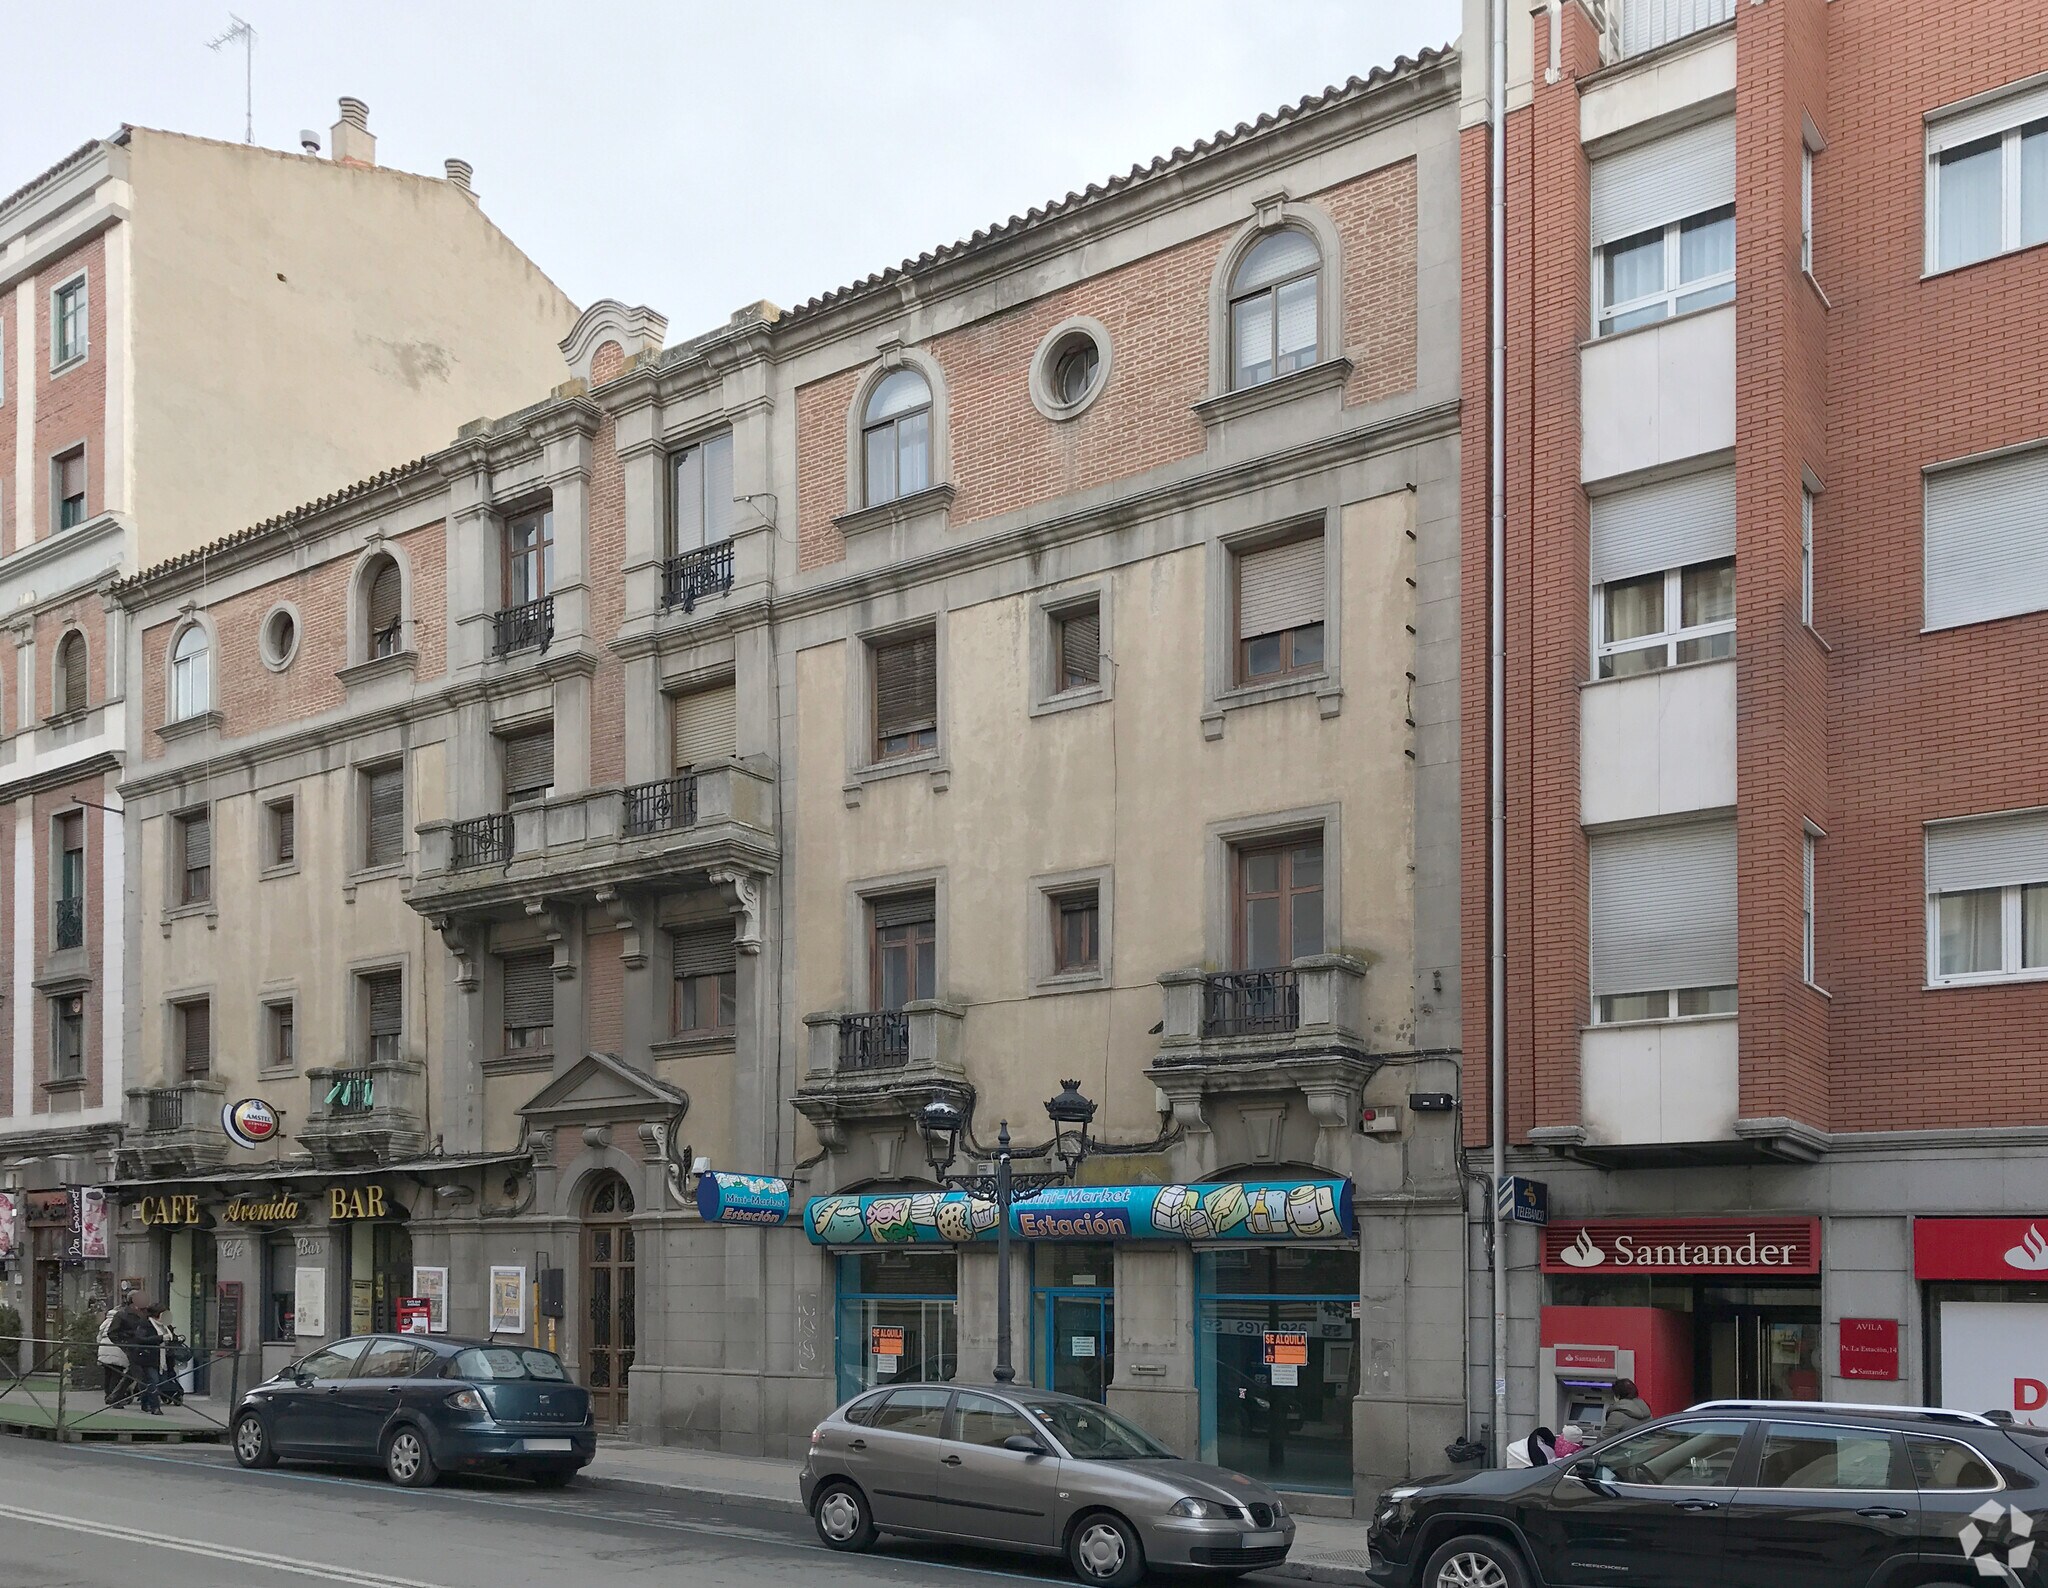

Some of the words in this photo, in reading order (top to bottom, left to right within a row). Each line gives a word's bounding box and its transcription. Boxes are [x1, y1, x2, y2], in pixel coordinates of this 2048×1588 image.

[246, 1113, 272, 1122] AMSTEL
[68, 1189, 81, 1233] Gourmet
[221, 1192, 299, 1223] Avenida
[329, 1185, 386, 1219] BAR
[721, 1207, 780, 1223] Estación
[1516, 1205, 1545, 1221] TELEBANCO
[1019, 1210, 1127, 1236] Estación
[68, 1238, 81, 1256] Don
[297, 1238, 322, 1256] Bar
[1614, 1232, 1797, 1266] Santander
[872, 1328, 880, 1338] SE
[880, 1328, 902, 1338] ALQUILA
[1856, 1323, 1883, 1331] AVILA
[1265, 1333, 1275, 1345] SE
[1275, 1334, 1306, 1346] ALQUILA
[1574, 1354, 1606, 1363] Santander
[1858, 1367, 1889, 1376] Santander
[2013, 1377, 2048, 1411] D
